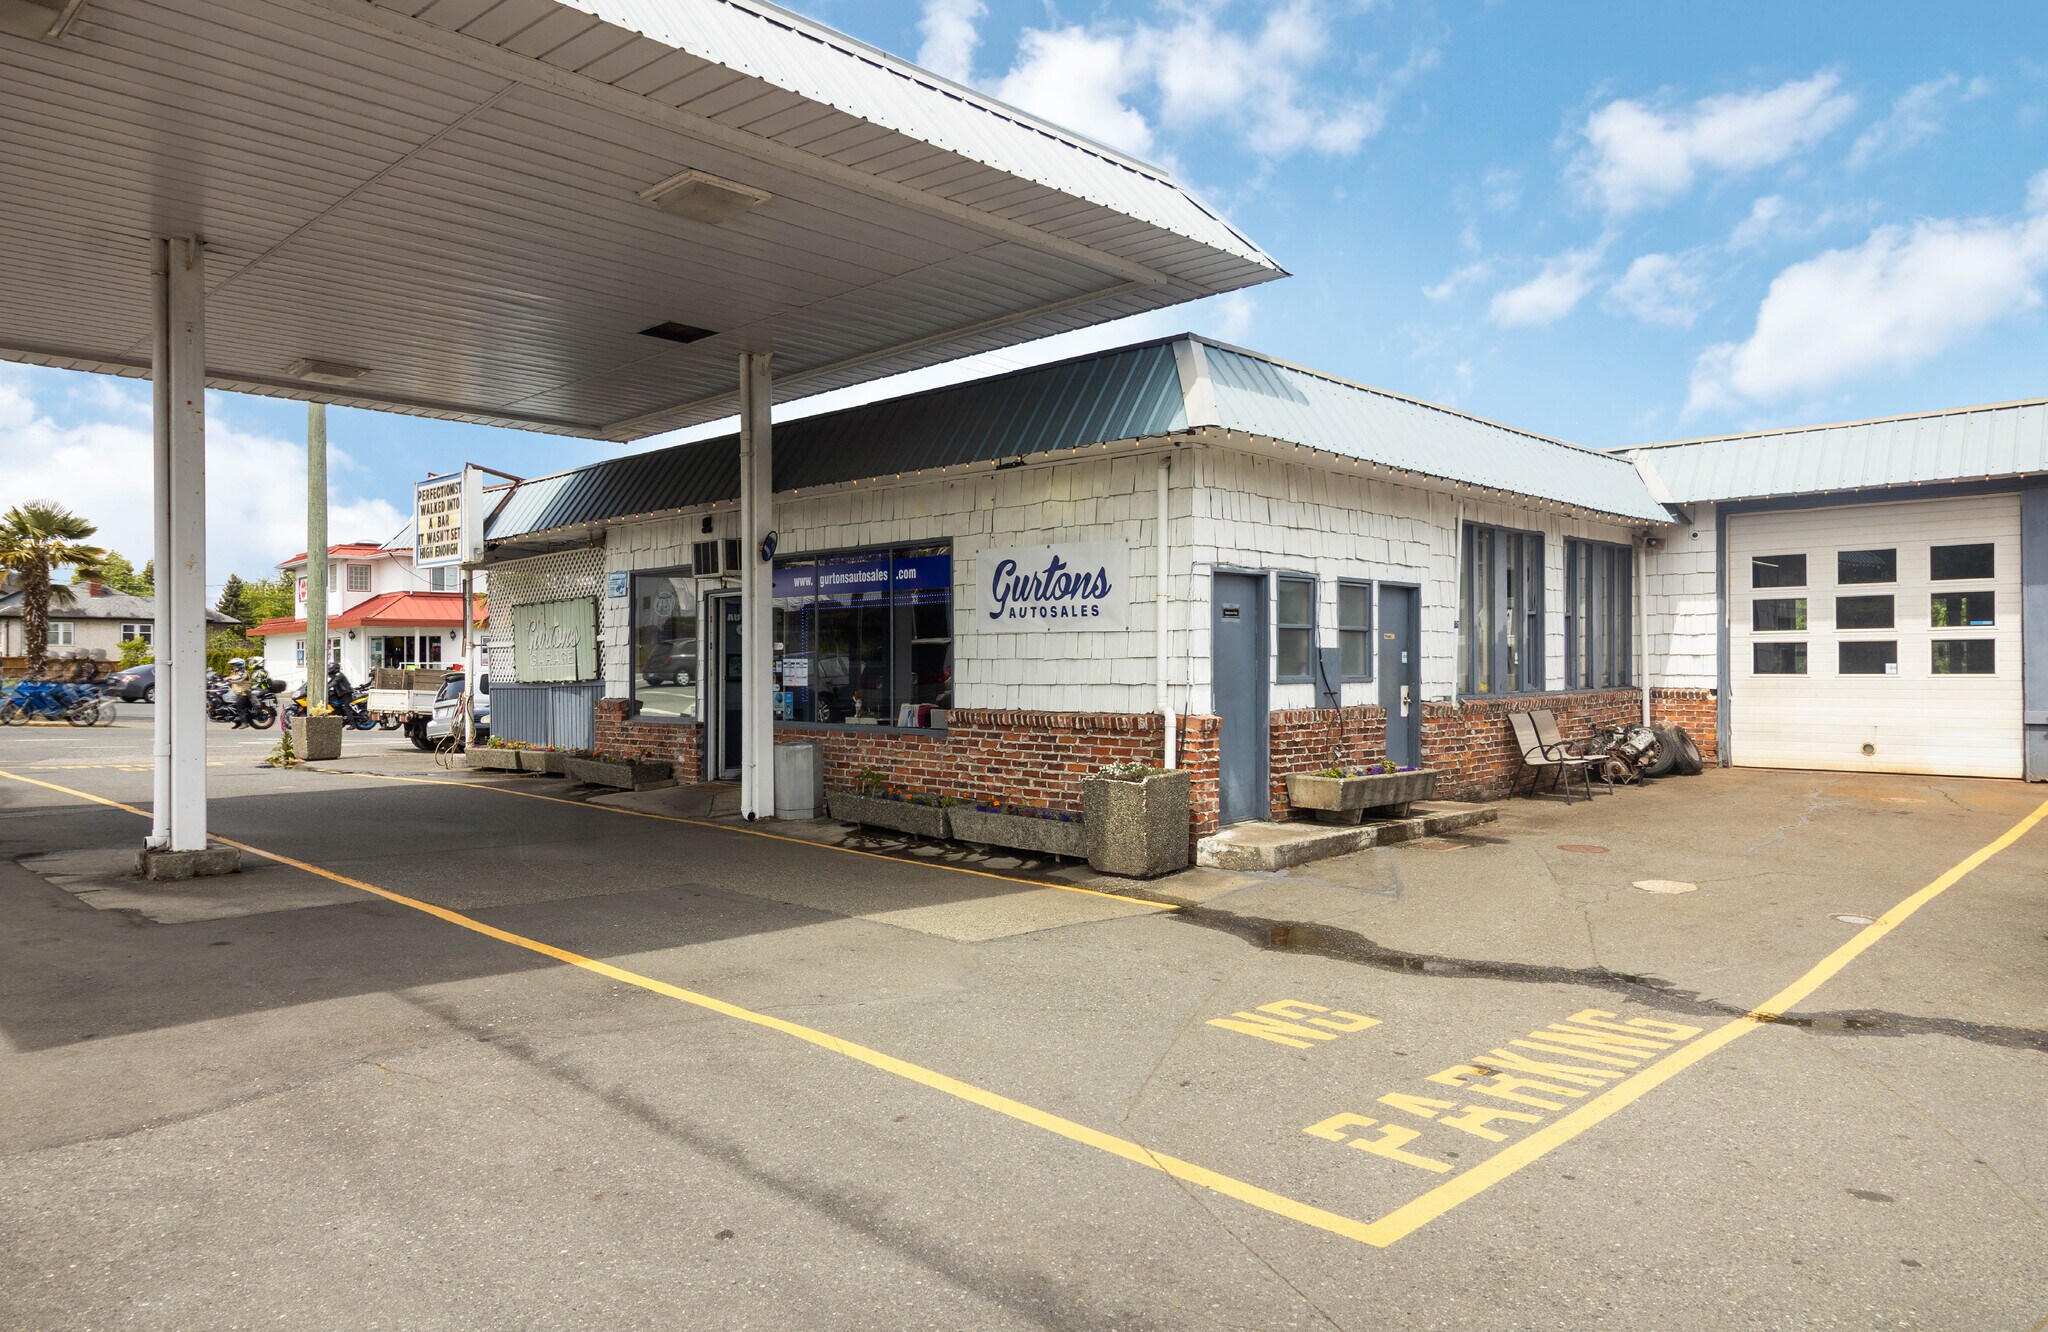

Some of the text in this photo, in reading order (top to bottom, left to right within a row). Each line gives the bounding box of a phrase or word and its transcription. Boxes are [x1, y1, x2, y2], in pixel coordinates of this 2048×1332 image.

[418, 482, 462, 502] PERFECTIONIST
[420, 497, 460, 516] WALKED INTO
[428, 515, 450, 529] A BAR
[418, 527, 461, 545] IT WASN'T SET
[420, 543, 458, 559] HIGH ENOUGH
[793, 568, 917, 587] www. gurtonsautosales .com
[989, 555, 1112, 619] Gurtons
[1009, 604, 1099, 618] AUTOSALES
[530, 650, 574, 667] GARAGE
[1205, 999, 1384, 1049] NO
[1301, 1008, 1704, 1174] PARKING
